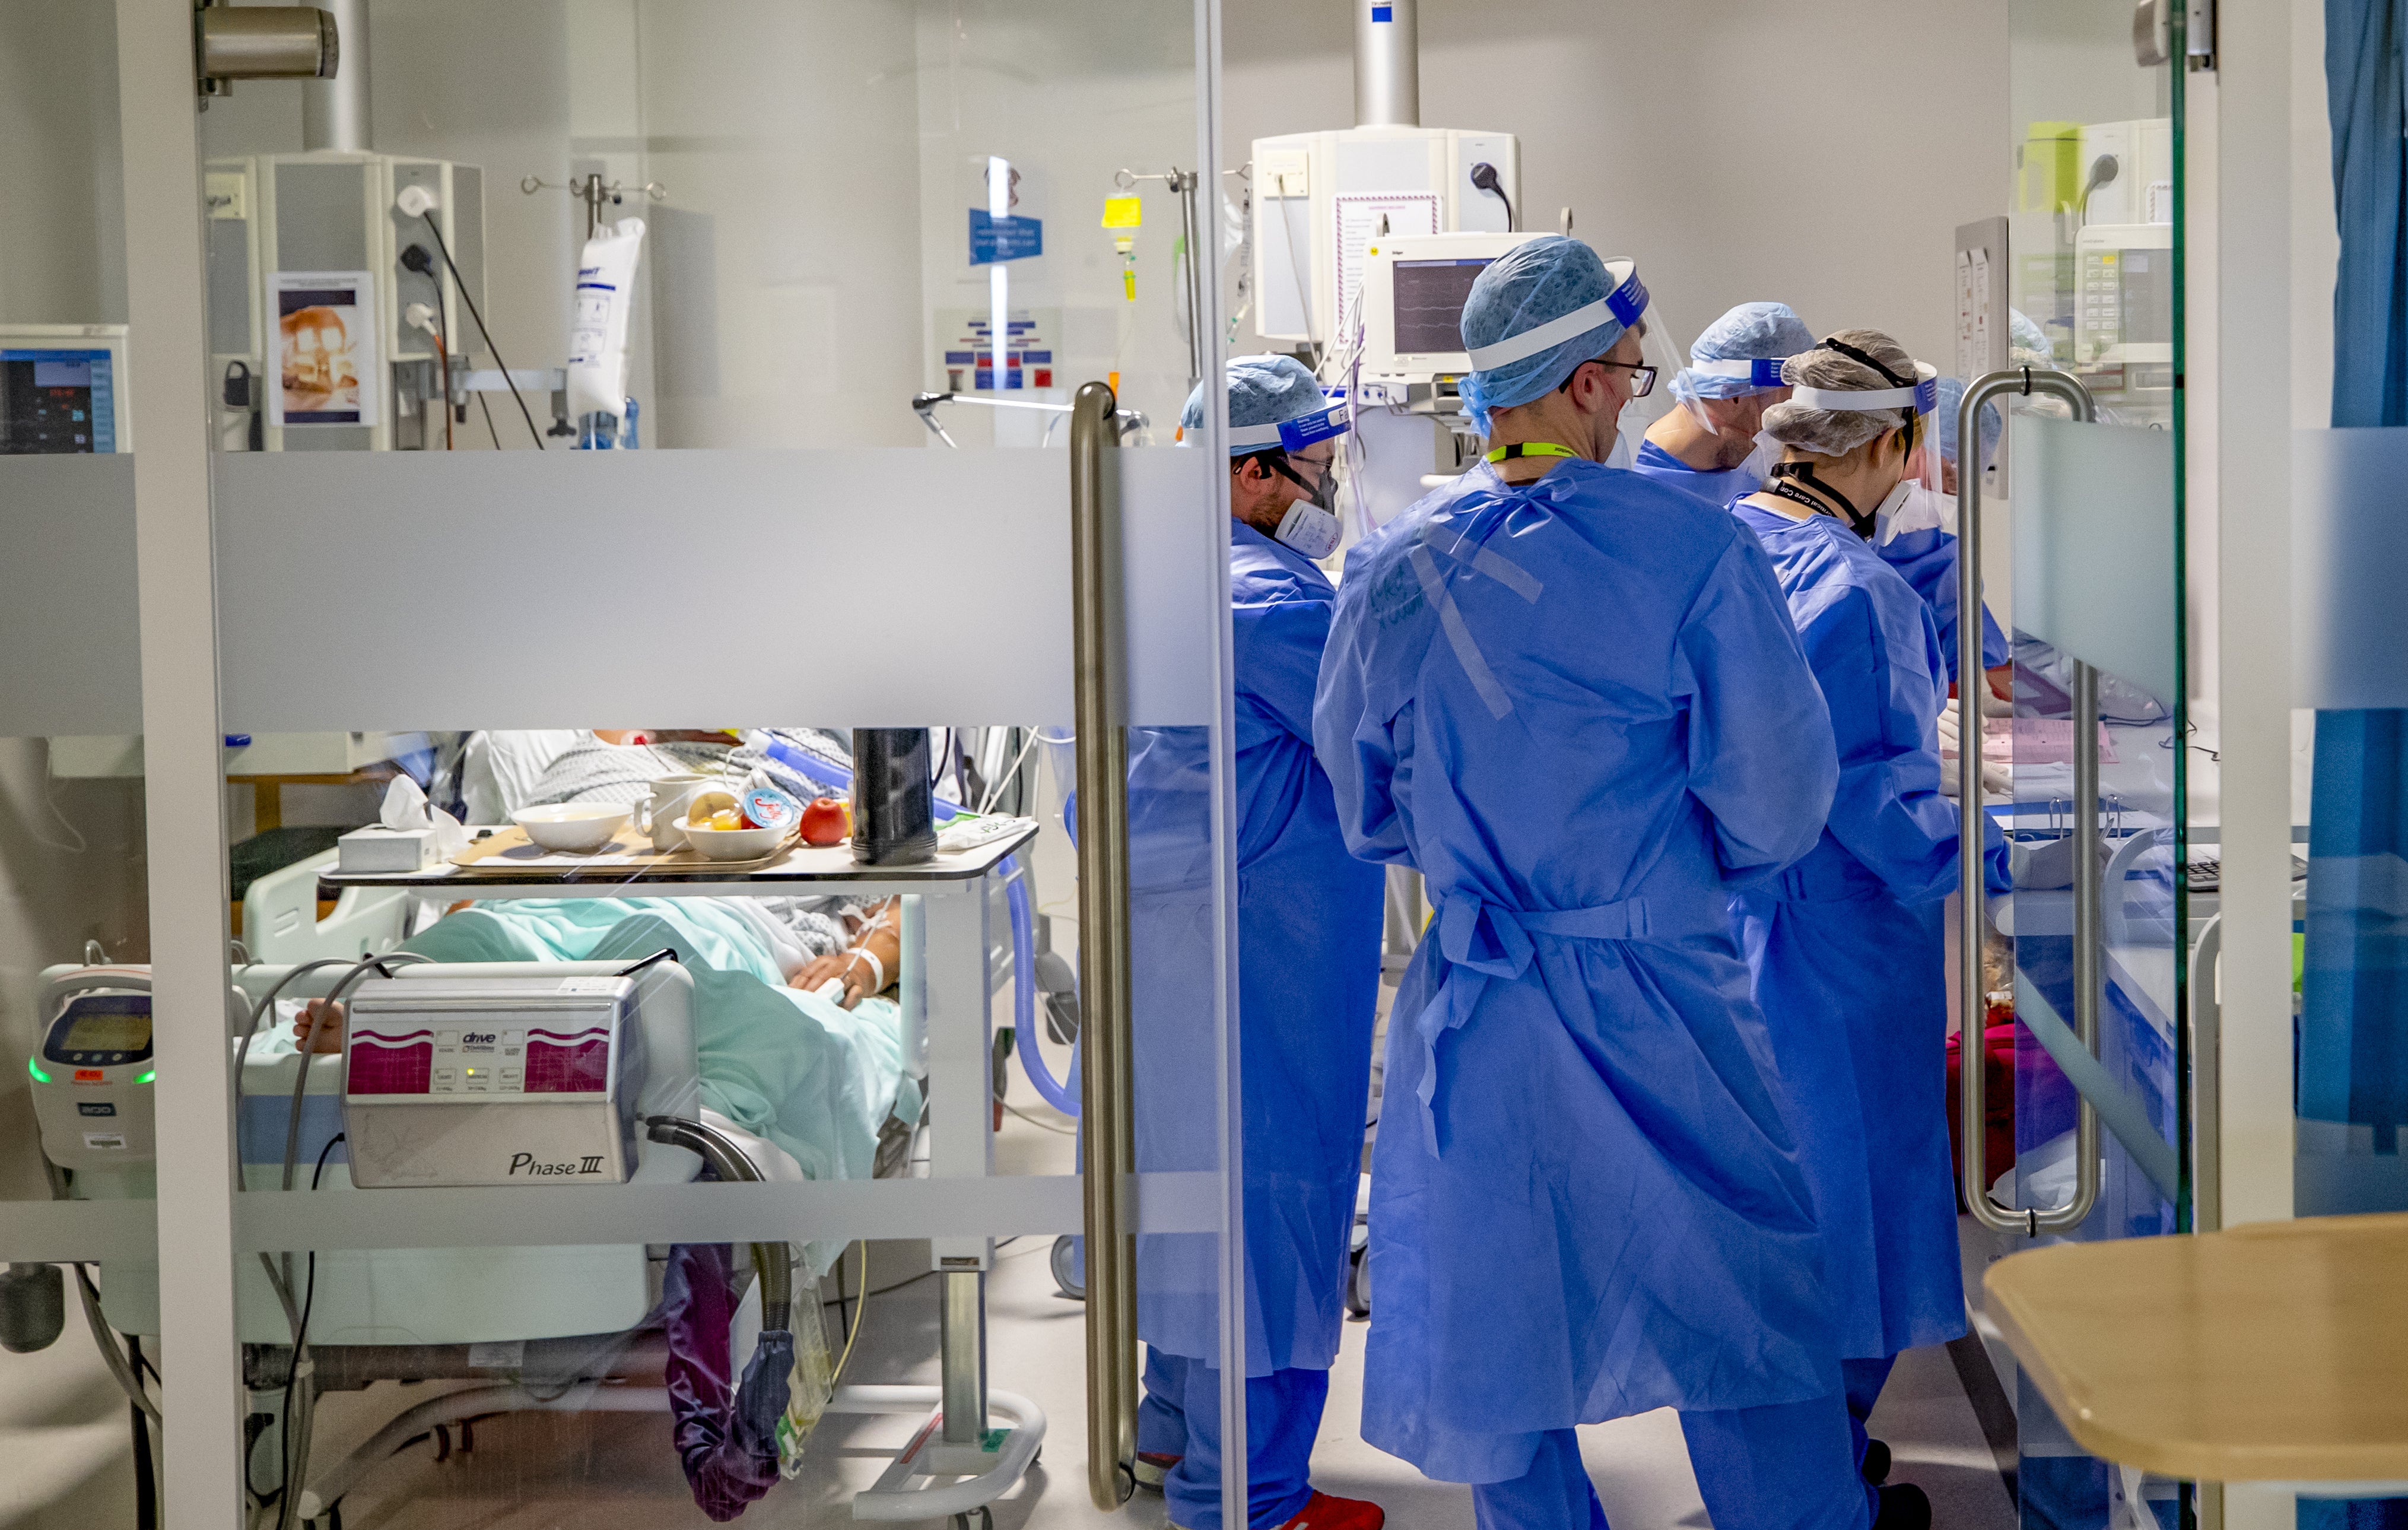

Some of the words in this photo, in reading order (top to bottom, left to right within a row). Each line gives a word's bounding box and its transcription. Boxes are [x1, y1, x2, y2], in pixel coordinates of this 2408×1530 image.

[1794, 491, 1811, 504] Care
[462, 1031, 496, 1043] drive
[508, 1153, 576, 1176] Phase
[577, 1156, 605, 1175] III
